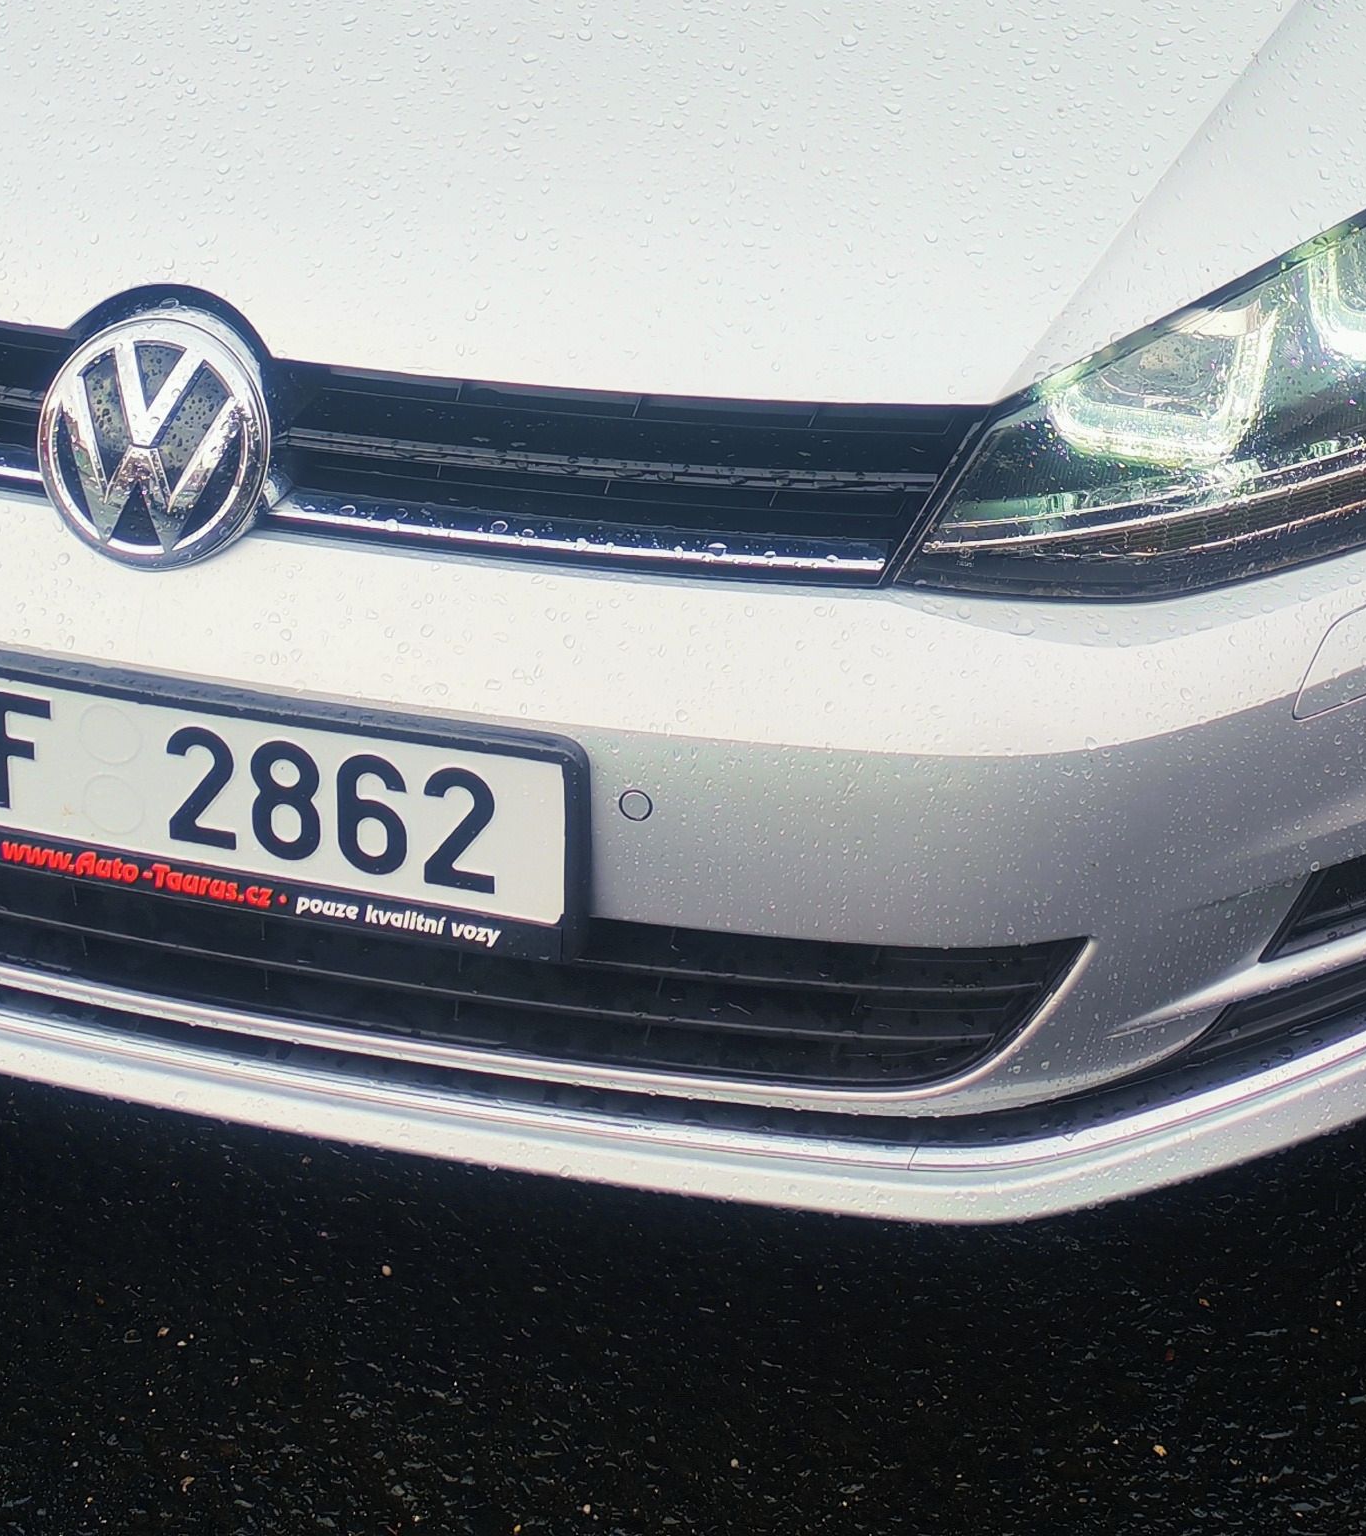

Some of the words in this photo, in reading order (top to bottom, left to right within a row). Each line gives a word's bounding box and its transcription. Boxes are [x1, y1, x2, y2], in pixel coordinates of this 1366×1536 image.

[166, 726, 496, 894] 2862
[295, 896, 359, 920] pouze
[365, 904, 447, 935] kvalitní
[451, 921, 502, 948] vozy
